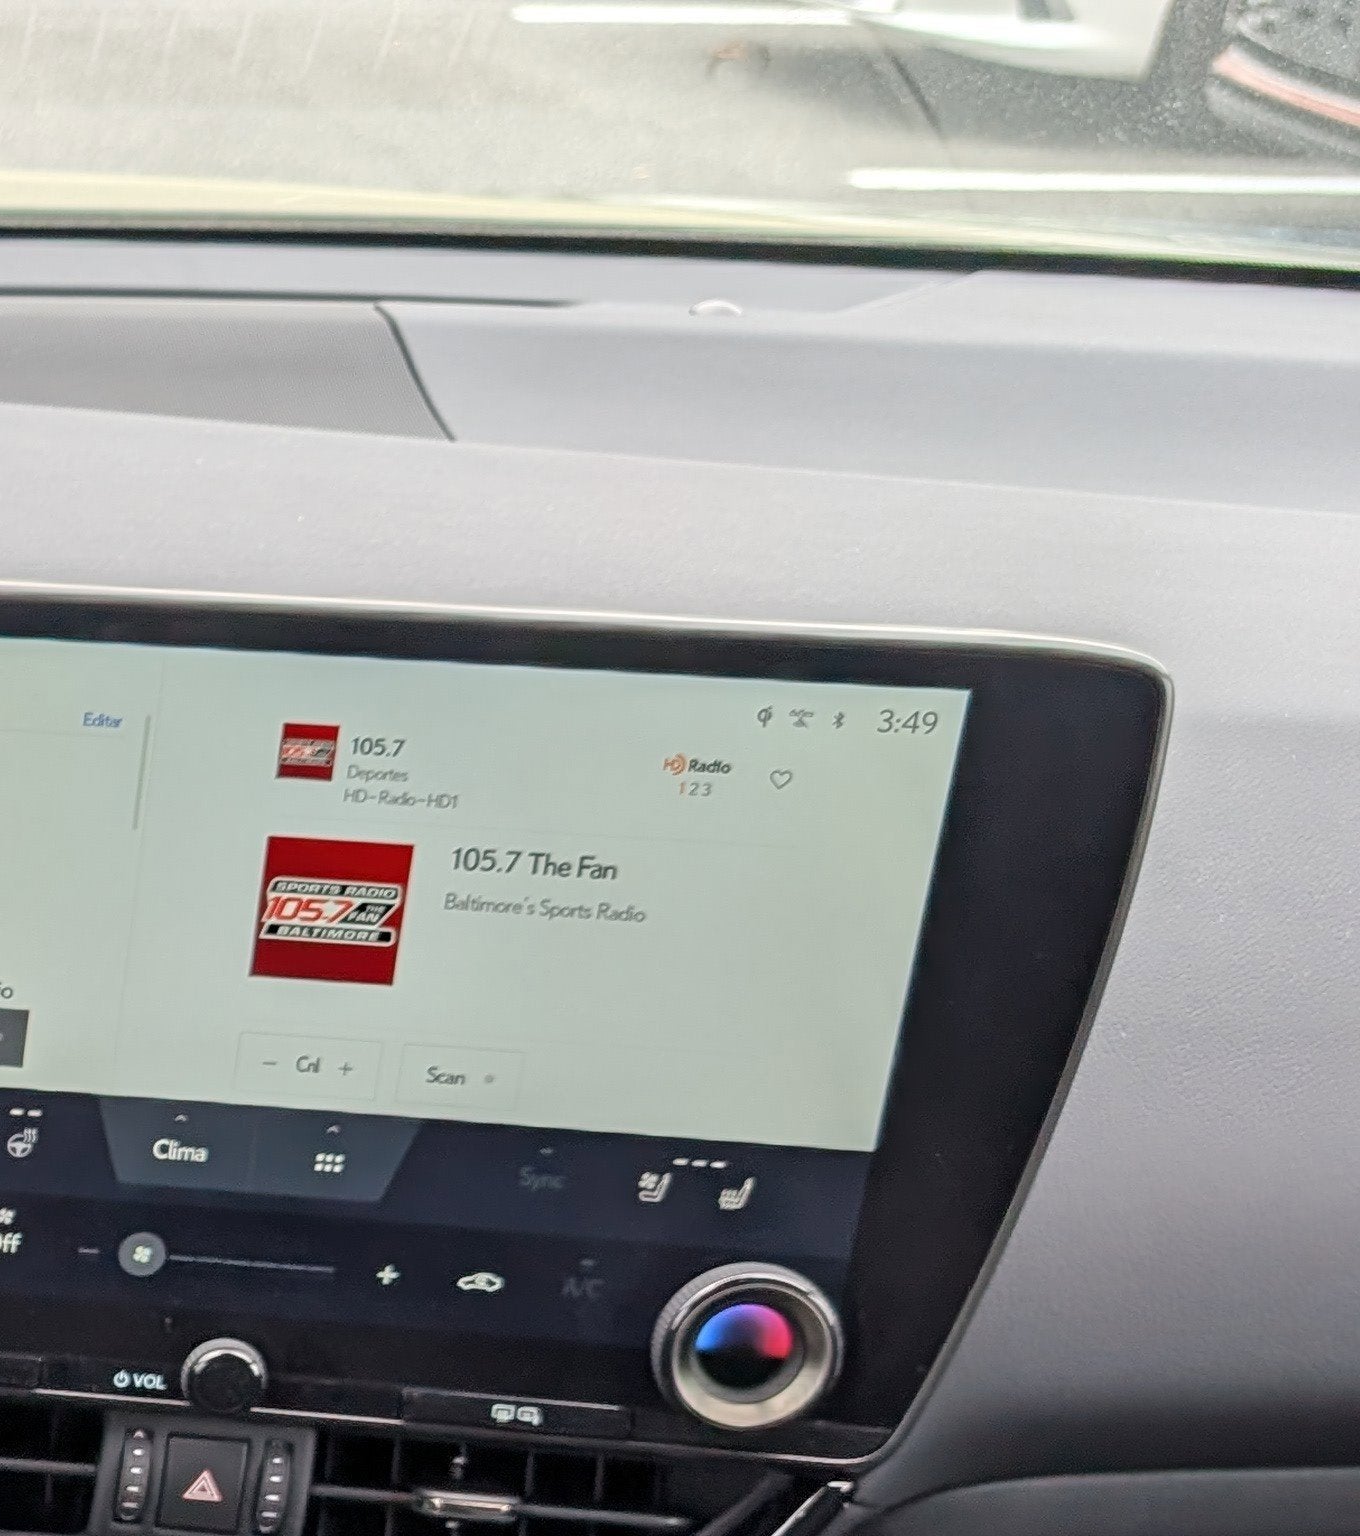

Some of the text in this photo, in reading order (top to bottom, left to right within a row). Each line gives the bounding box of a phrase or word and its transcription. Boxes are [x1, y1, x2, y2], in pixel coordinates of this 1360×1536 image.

[83, 713, 122, 728] Editar
[877, 709, 938, 734] 3:49
[351, 736, 406, 757] 105.7
[347, 765, 409, 782] Deportes
[689, 758, 731, 774] Radio
[452, 847, 618, 880] 105.7 The Fan
[276, 881, 396, 898] SPORTS RADIO
[260, 896, 355, 923] 105.7
[347, 911, 379, 923] FAN
[539, 898, 591, 920] Sports
[596, 902, 646, 923] Radio
[276, 925, 380, 941] BALTIMORE
[426, 1065, 466, 1085] Scan
[153, 1138, 209, 1164] Clima
[133, 1373, 166, 1392] VOL
